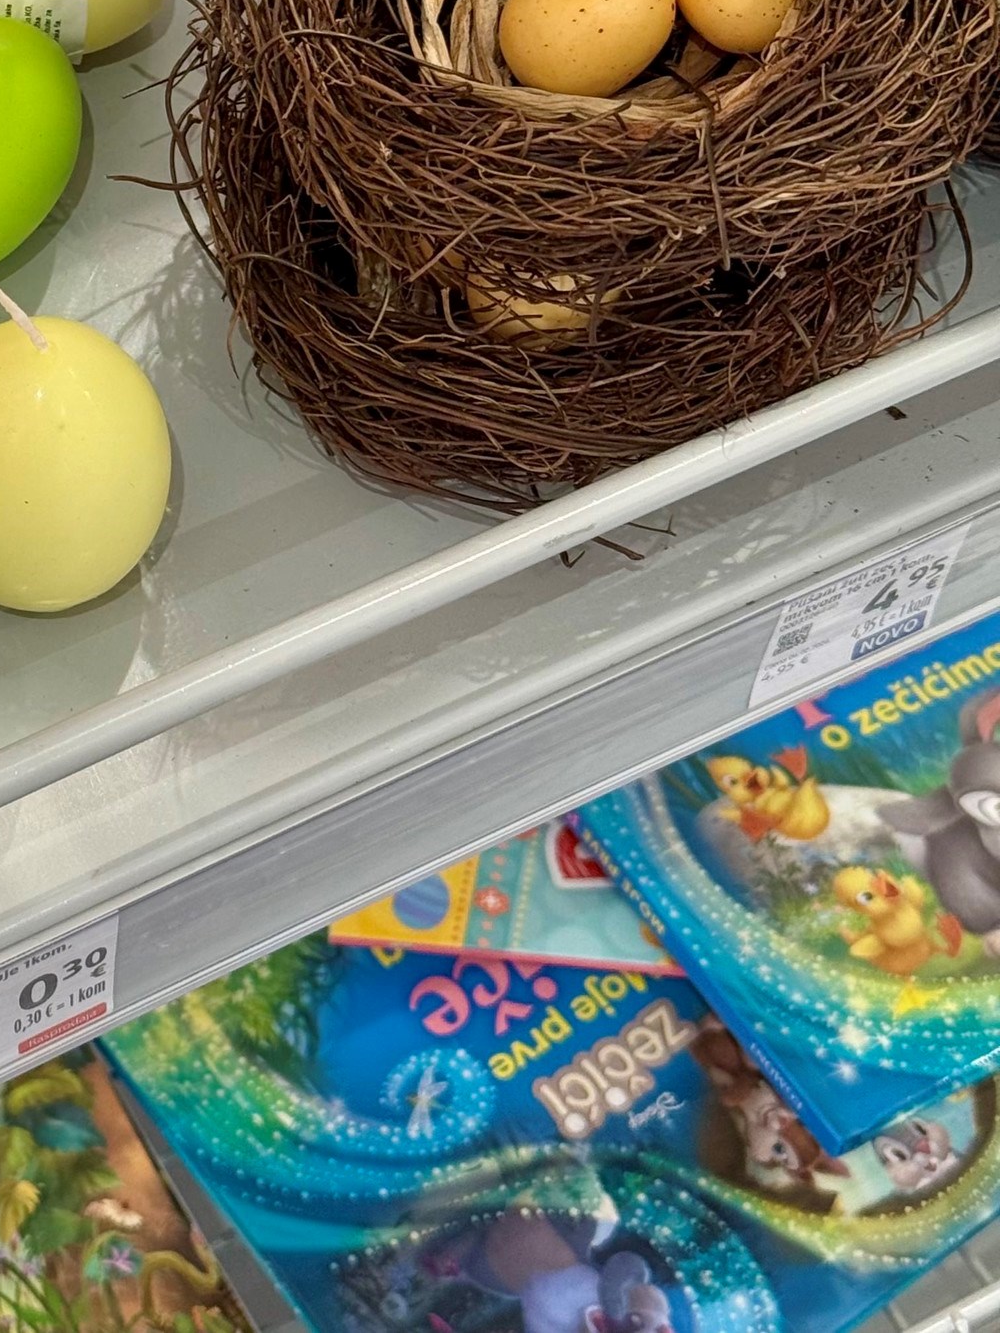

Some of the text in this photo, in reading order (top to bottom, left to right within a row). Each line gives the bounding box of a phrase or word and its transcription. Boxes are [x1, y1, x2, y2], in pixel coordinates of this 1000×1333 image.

[859, 618, 918, 654] NOVO
[820, 724, 850, 751] o
[14, 1009, 42, 1035] 0,30
[45, 1003, 54, 1018] €
[78, 979, 106, 1003] kom
[488, 1006, 574, 1081] prve
[535, 1000, 694, 1137] zečići
